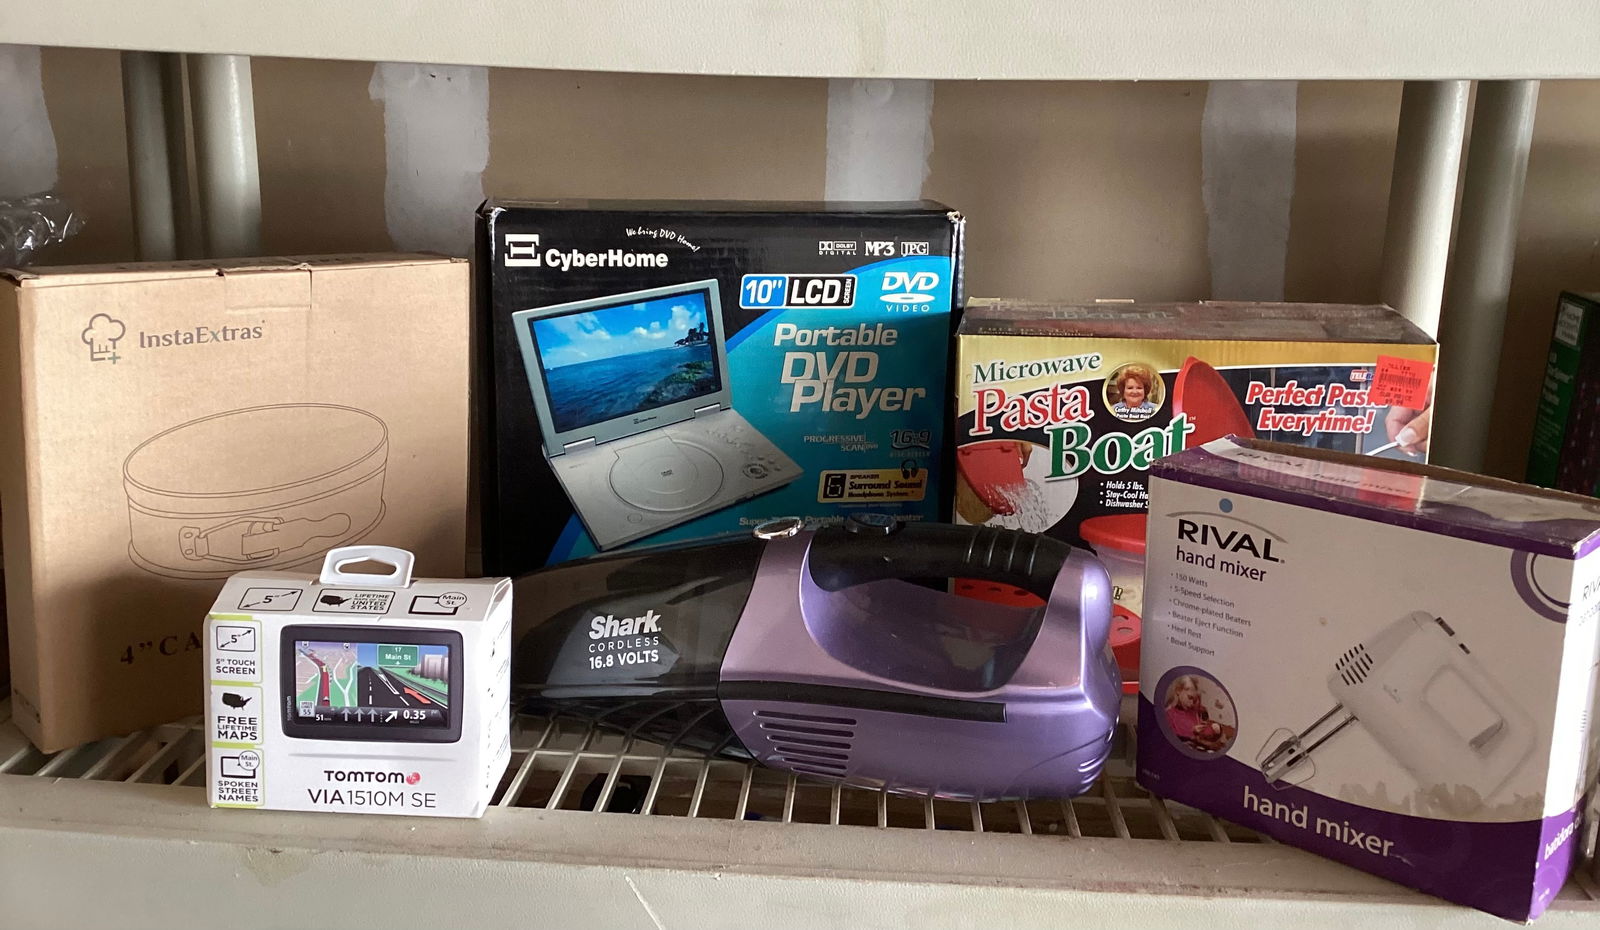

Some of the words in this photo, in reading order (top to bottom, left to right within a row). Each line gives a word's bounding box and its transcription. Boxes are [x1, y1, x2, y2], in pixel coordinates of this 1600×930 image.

[659, 228, 676, 240] DVD
[865, 241, 895, 256] MP3
[902, 242, 928, 257] JPG
[545, 248, 669, 271] CyberHome
[790, 279, 841, 304] LCD
[843, 279, 852, 304] SCREEN
[881, 272, 939, 293] DVD
[886, 304, 930, 312] VIDEO
[139, 325, 263, 349] InstaExtras
[774, 323, 898, 346] Portable
[780, 351, 879, 384] DVD
[973, 353, 1101, 384] Microwave
[790, 379, 926, 419] Player
[1246, 380, 1326, 406] Perfect
[1326, 383, 1388, 408] Pas
[969, 384, 1095, 436] Pasta
[1257, 408, 1376, 436] Everytime!
[1044, 413, 1195, 482] Boat
[849, 480, 891, 490] Surround
[894, 480, 922, 489] Sound
[1105, 480, 1125, 489] Holds
[1105, 498, 1144, 508] Dishwasher
[1178, 518, 1280, 563] RIVAL
[1176, 545, 1216, 569] hand
[1220, 561, 1267, 582] mixer
[1175, 572, 1187, 582] 150
[1188, 575, 1208, 588] Watts
[1174, 585, 1202, 600] 5-Speed
[1203, 593, 1235, 609] Selection
[1173, 598, 1224, 619] Chrome-plated
[1225, 612, 1252, 627] Beaters
[1171, 623, 1187, 635] Heel
[1187, 628, 1202, 639] Rest
[1172, 610, 1194, 623] Beater
[1194, 615, 1211, 629] Eject
[1212, 623, 1244, 638] Function
[159, 631, 201, 656] CA
[588, 636, 659, 653] CORDLESS
[1188, 641, 1215, 657] Support
[216, 665, 256, 675] SCREEN
[227, 658, 255, 667] TOUCH
[589, 654, 614, 670] 16.8
[617, 650, 659, 666] VOLTS
[217, 715, 257, 725] FREE
[403, 709, 426, 720] 0.35
[218, 730, 258, 741] MAPS
[218, 780, 258, 788] SPOKEN
[218, 787, 259, 795] STREET
[218, 794, 259, 802] NAMES
[411, 792, 437, 809] SE
[1243, 785, 1309, 829] hand
[1315, 817, 1394, 857] mixer
